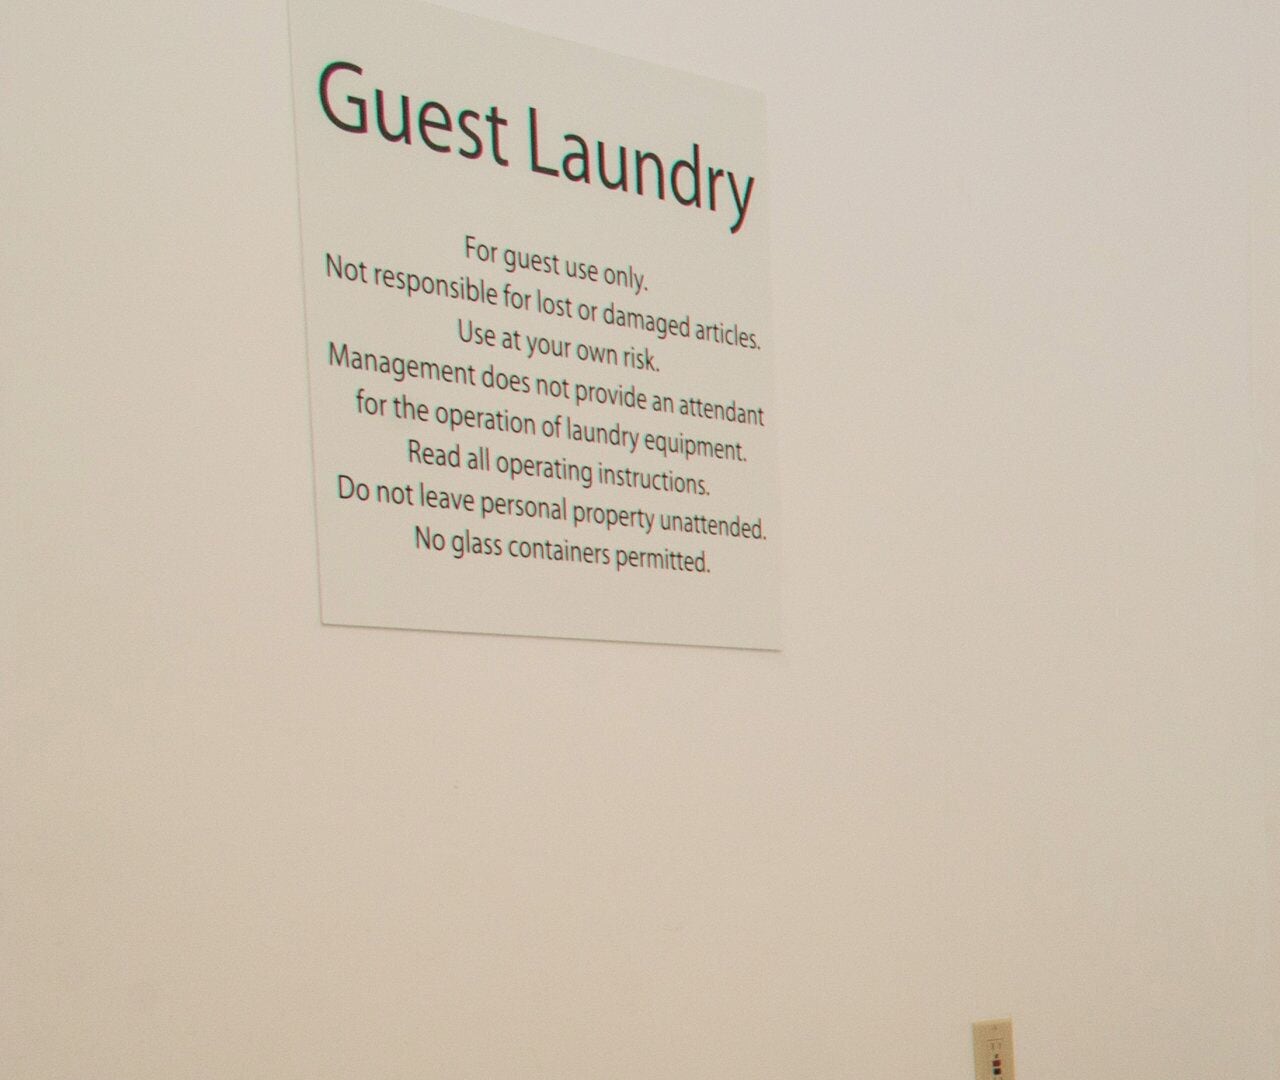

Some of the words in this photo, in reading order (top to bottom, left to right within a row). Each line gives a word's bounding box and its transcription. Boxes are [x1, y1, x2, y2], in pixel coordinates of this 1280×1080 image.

[319, 61, 509, 167] Guest
[529, 107, 754, 234] Laundry
[466, 235, 498, 263] For
[504, 249, 560, 275] guest
[566, 261, 598, 282] use
[604, 266, 648, 295] only.
[326, 253, 368, 283] Not
[375, 268, 498, 305] responsible
[503, 283, 531, 310] for
[538, 289, 572, 318] lost
[578, 304, 598, 321] or
[603, 302, 690, 340] damaged
[696, 323, 760, 349] articles.
[458, 319, 496, 347] Use
[502, 331, 521, 351] at
[526, 336, 571, 359] your
[577, 344, 618, 365] own
[624, 347, 659, 372] risk.
[330, 342, 476, 386] Management
[482, 365, 530, 393] does
[537, 379, 570, 399] not
[576, 384, 647, 410] provide
[652, 395, 674, 413] an
[680, 398, 764, 426] attendant
[356, 389, 387, 416] for
[393, 394, 429, 422] the
[436, 406, 535, 435] operation
[542, 415, 562, 438] of
[567, 417, 639, 453] laundry
[645, 433, 746, 461] equipment.
[409, 439, 460, 468] Read
[468, 447, 490, 471] all
[497, 456, 592, 489] operating
[599, 462, 709, 495] instructions.
[338, 475, 370, 501] Do
[377, 485, 414, 506] not
[420, 482, 475, 511] leave
[481, 496, 567, 520] personal
[573, 506, 654, 534] property
[661, 515, 766, 540] unattended.
[415, 526, 445, 551] No
[452, 529, 502, 559] glass
[508, 540, 610, 565] containers
[616, 549, 710, 573] permitted.
